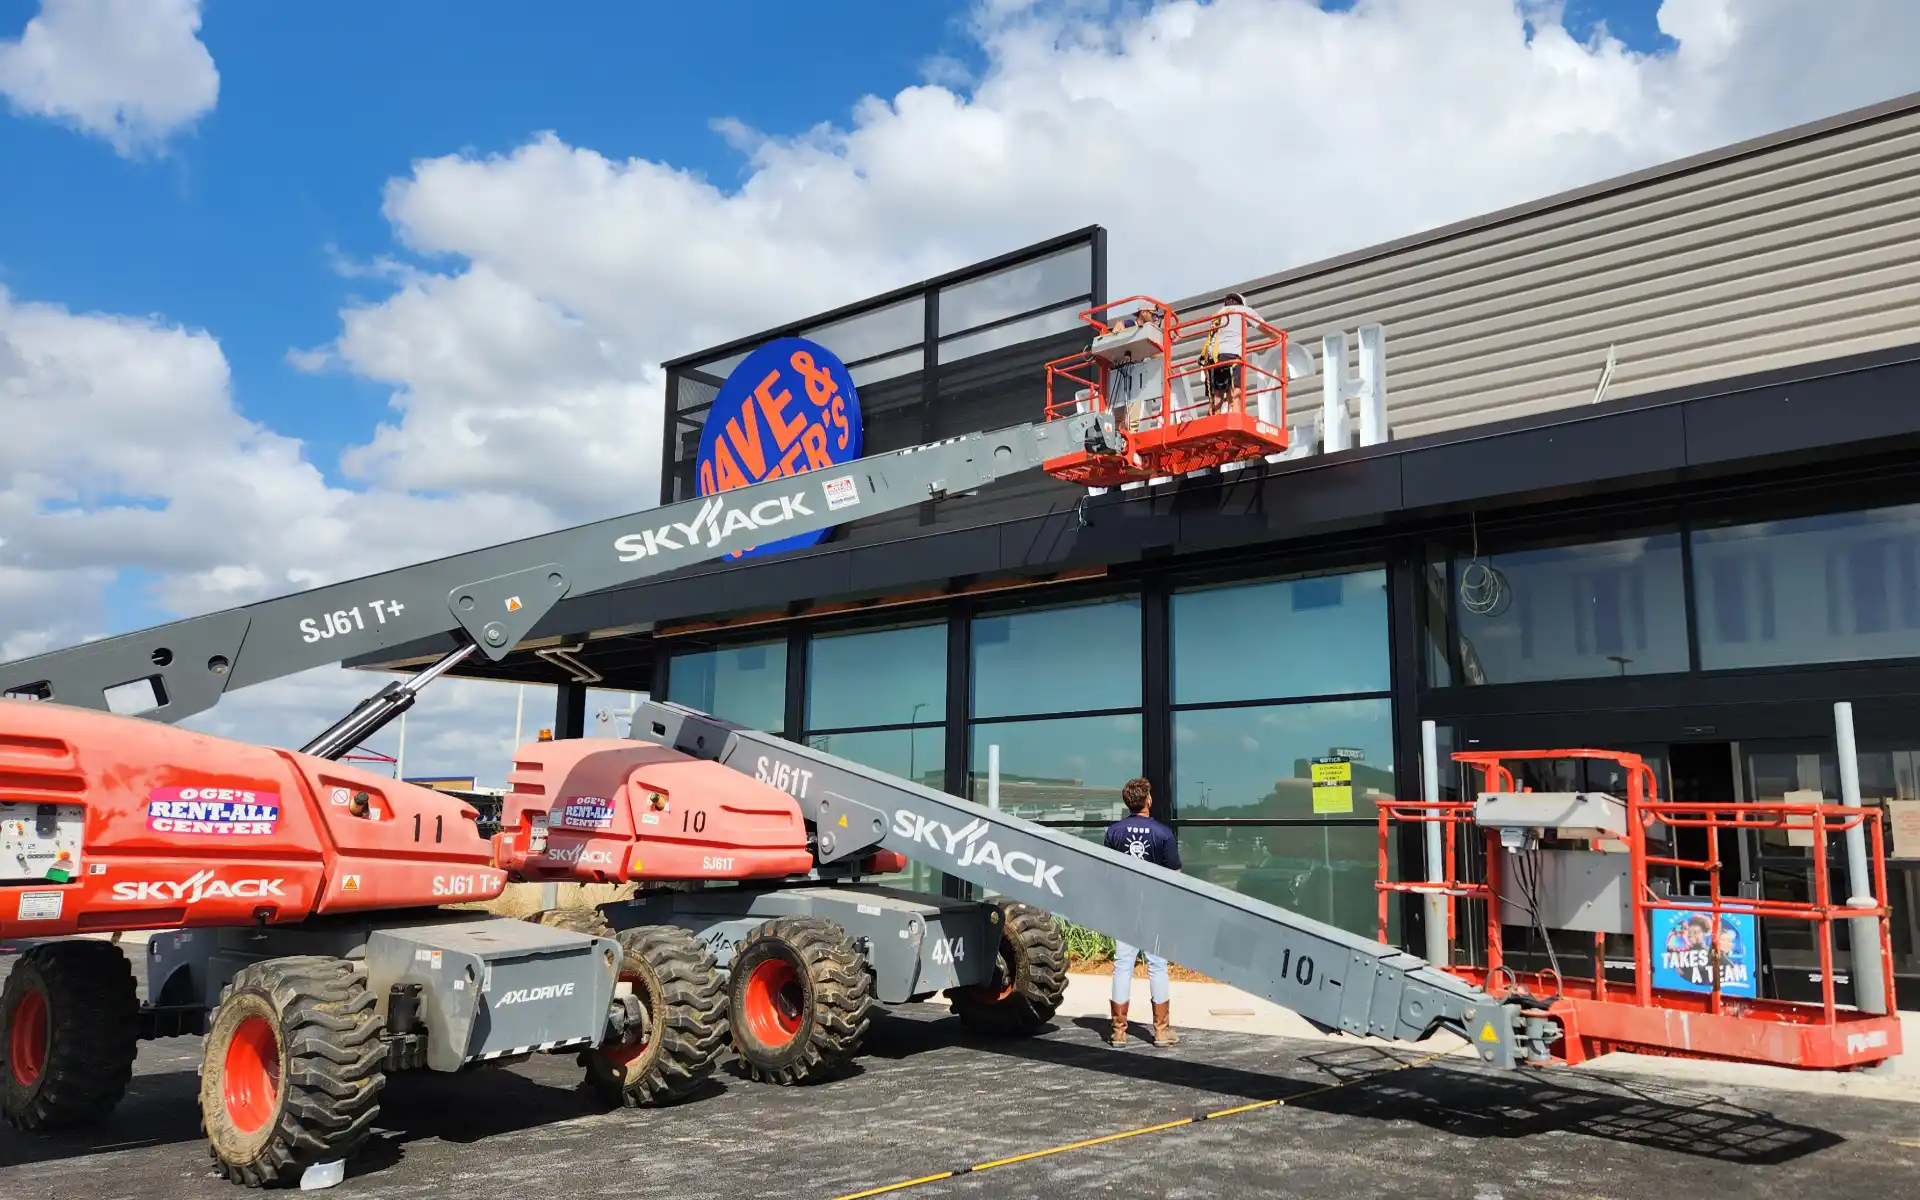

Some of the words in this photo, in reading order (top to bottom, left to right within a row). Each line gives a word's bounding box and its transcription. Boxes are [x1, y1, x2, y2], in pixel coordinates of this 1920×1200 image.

[789, 350, 839, 407] &
[614, 491, 815, 562] SKYJACK
[299, 606, 365, 643] SJ61
[369, 599, 405, 624] T+
[756, 755, 813, 799] SJ61T
[179, 787, 256, 803] OGE'S
[576, 796, 606, 806] OGE'S
[149, 801, 279, 823] RENT-ALL
[565, 805, 615, 819] RENT-ALL
[565, 818, 611, 828] CENTER
[682, 810, 706, 833] 10
[151, 819, 273, 836] CENTER
[548, 843, 613, 865] SKYJACK
[702, 856, 735, 871] SJ61T
[893, 808, 1065, 897] SKYJACK
[112, 869, 286, 904] SKYJACK
[431, 874, 474, 897] SJ61
[478, 873, 502, 895] T+
[931, 936, 965, 965] 4X4
[1661, 949, 1709, 969] TAKES
[1281, 948, 1315, 986] 10
[1691, 965, 1703, 984] A
[494, 982, 575, 1009] AXLDRIVE
